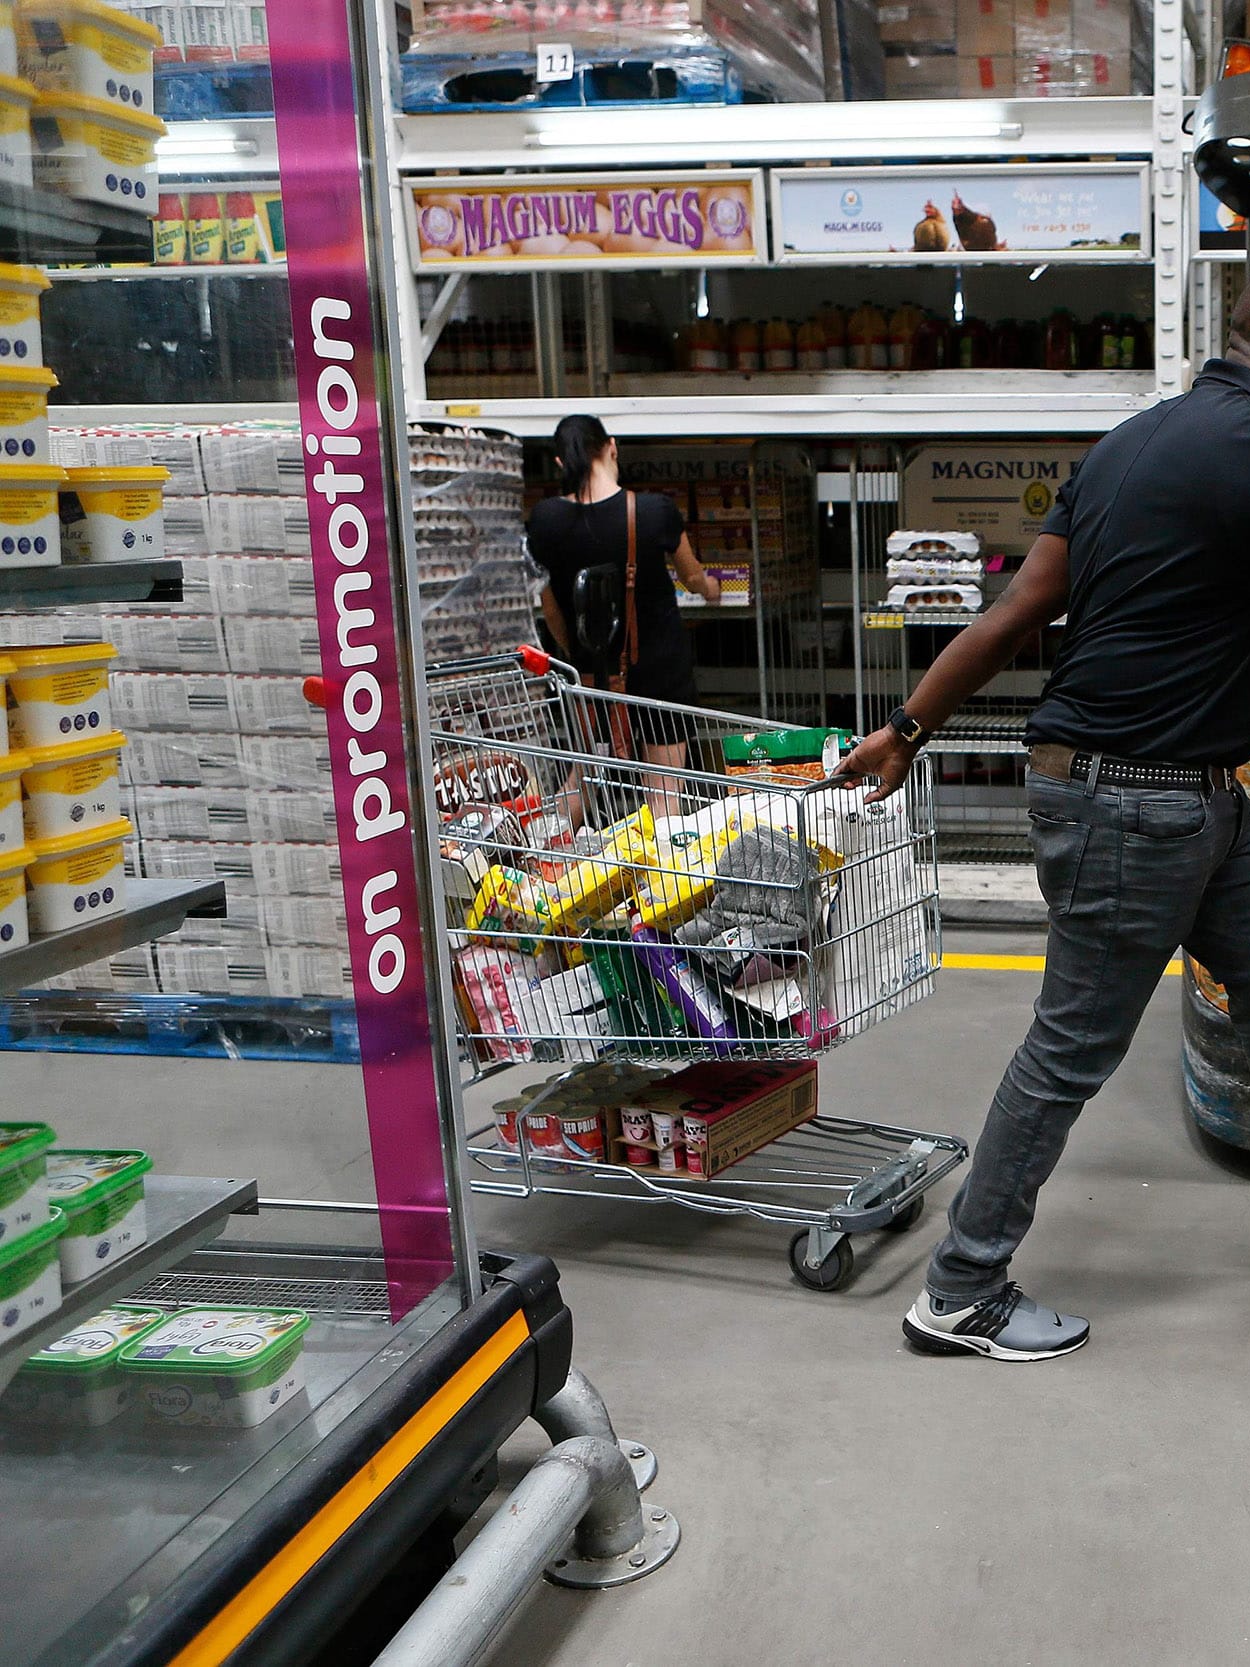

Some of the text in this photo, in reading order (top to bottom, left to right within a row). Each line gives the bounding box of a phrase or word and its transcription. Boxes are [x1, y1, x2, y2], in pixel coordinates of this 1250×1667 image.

[546, 54, 570, 73] 11
[461, 187, 705, 256] MAGNUM EGGS
[931, 461, 1059, 480] MAGNUM
[306, 296, 406, 995] on promotion
[435, 762, 522, 806] TASTIC
[528, 1116, 548, 1129] PRIDE
[577, 1117, 598, 1134] PRIDE
[207, 1340, 261, 1351] Flora
